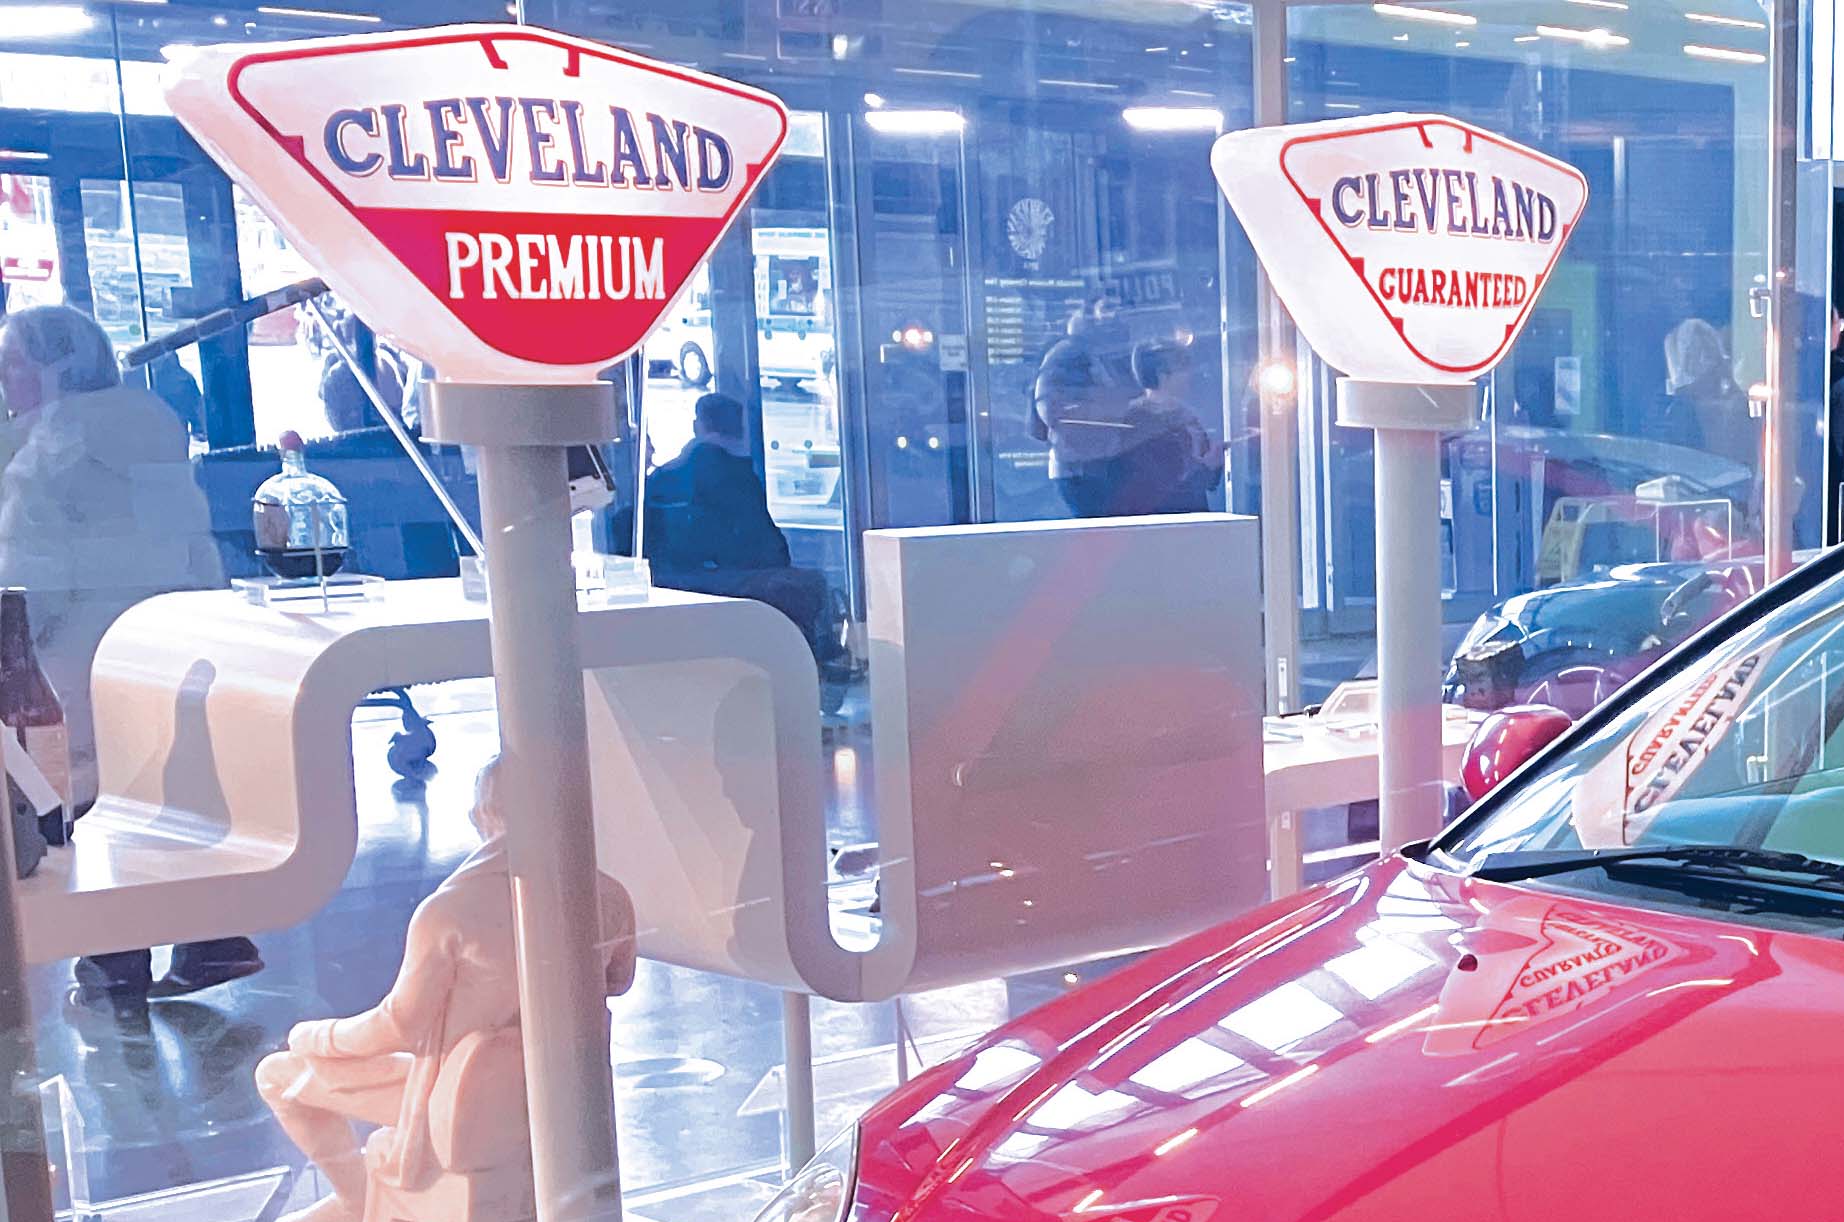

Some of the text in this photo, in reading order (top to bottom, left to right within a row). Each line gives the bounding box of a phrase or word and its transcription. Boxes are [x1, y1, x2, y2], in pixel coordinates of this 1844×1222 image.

[324, 97, 733, 191] CLEVELAND
[1332, 169, 1557, 243] CLEVELAND
[445, 232, 665, 300] PREMIUM
[1379, 267, 1527, 308] GUARANTEED
